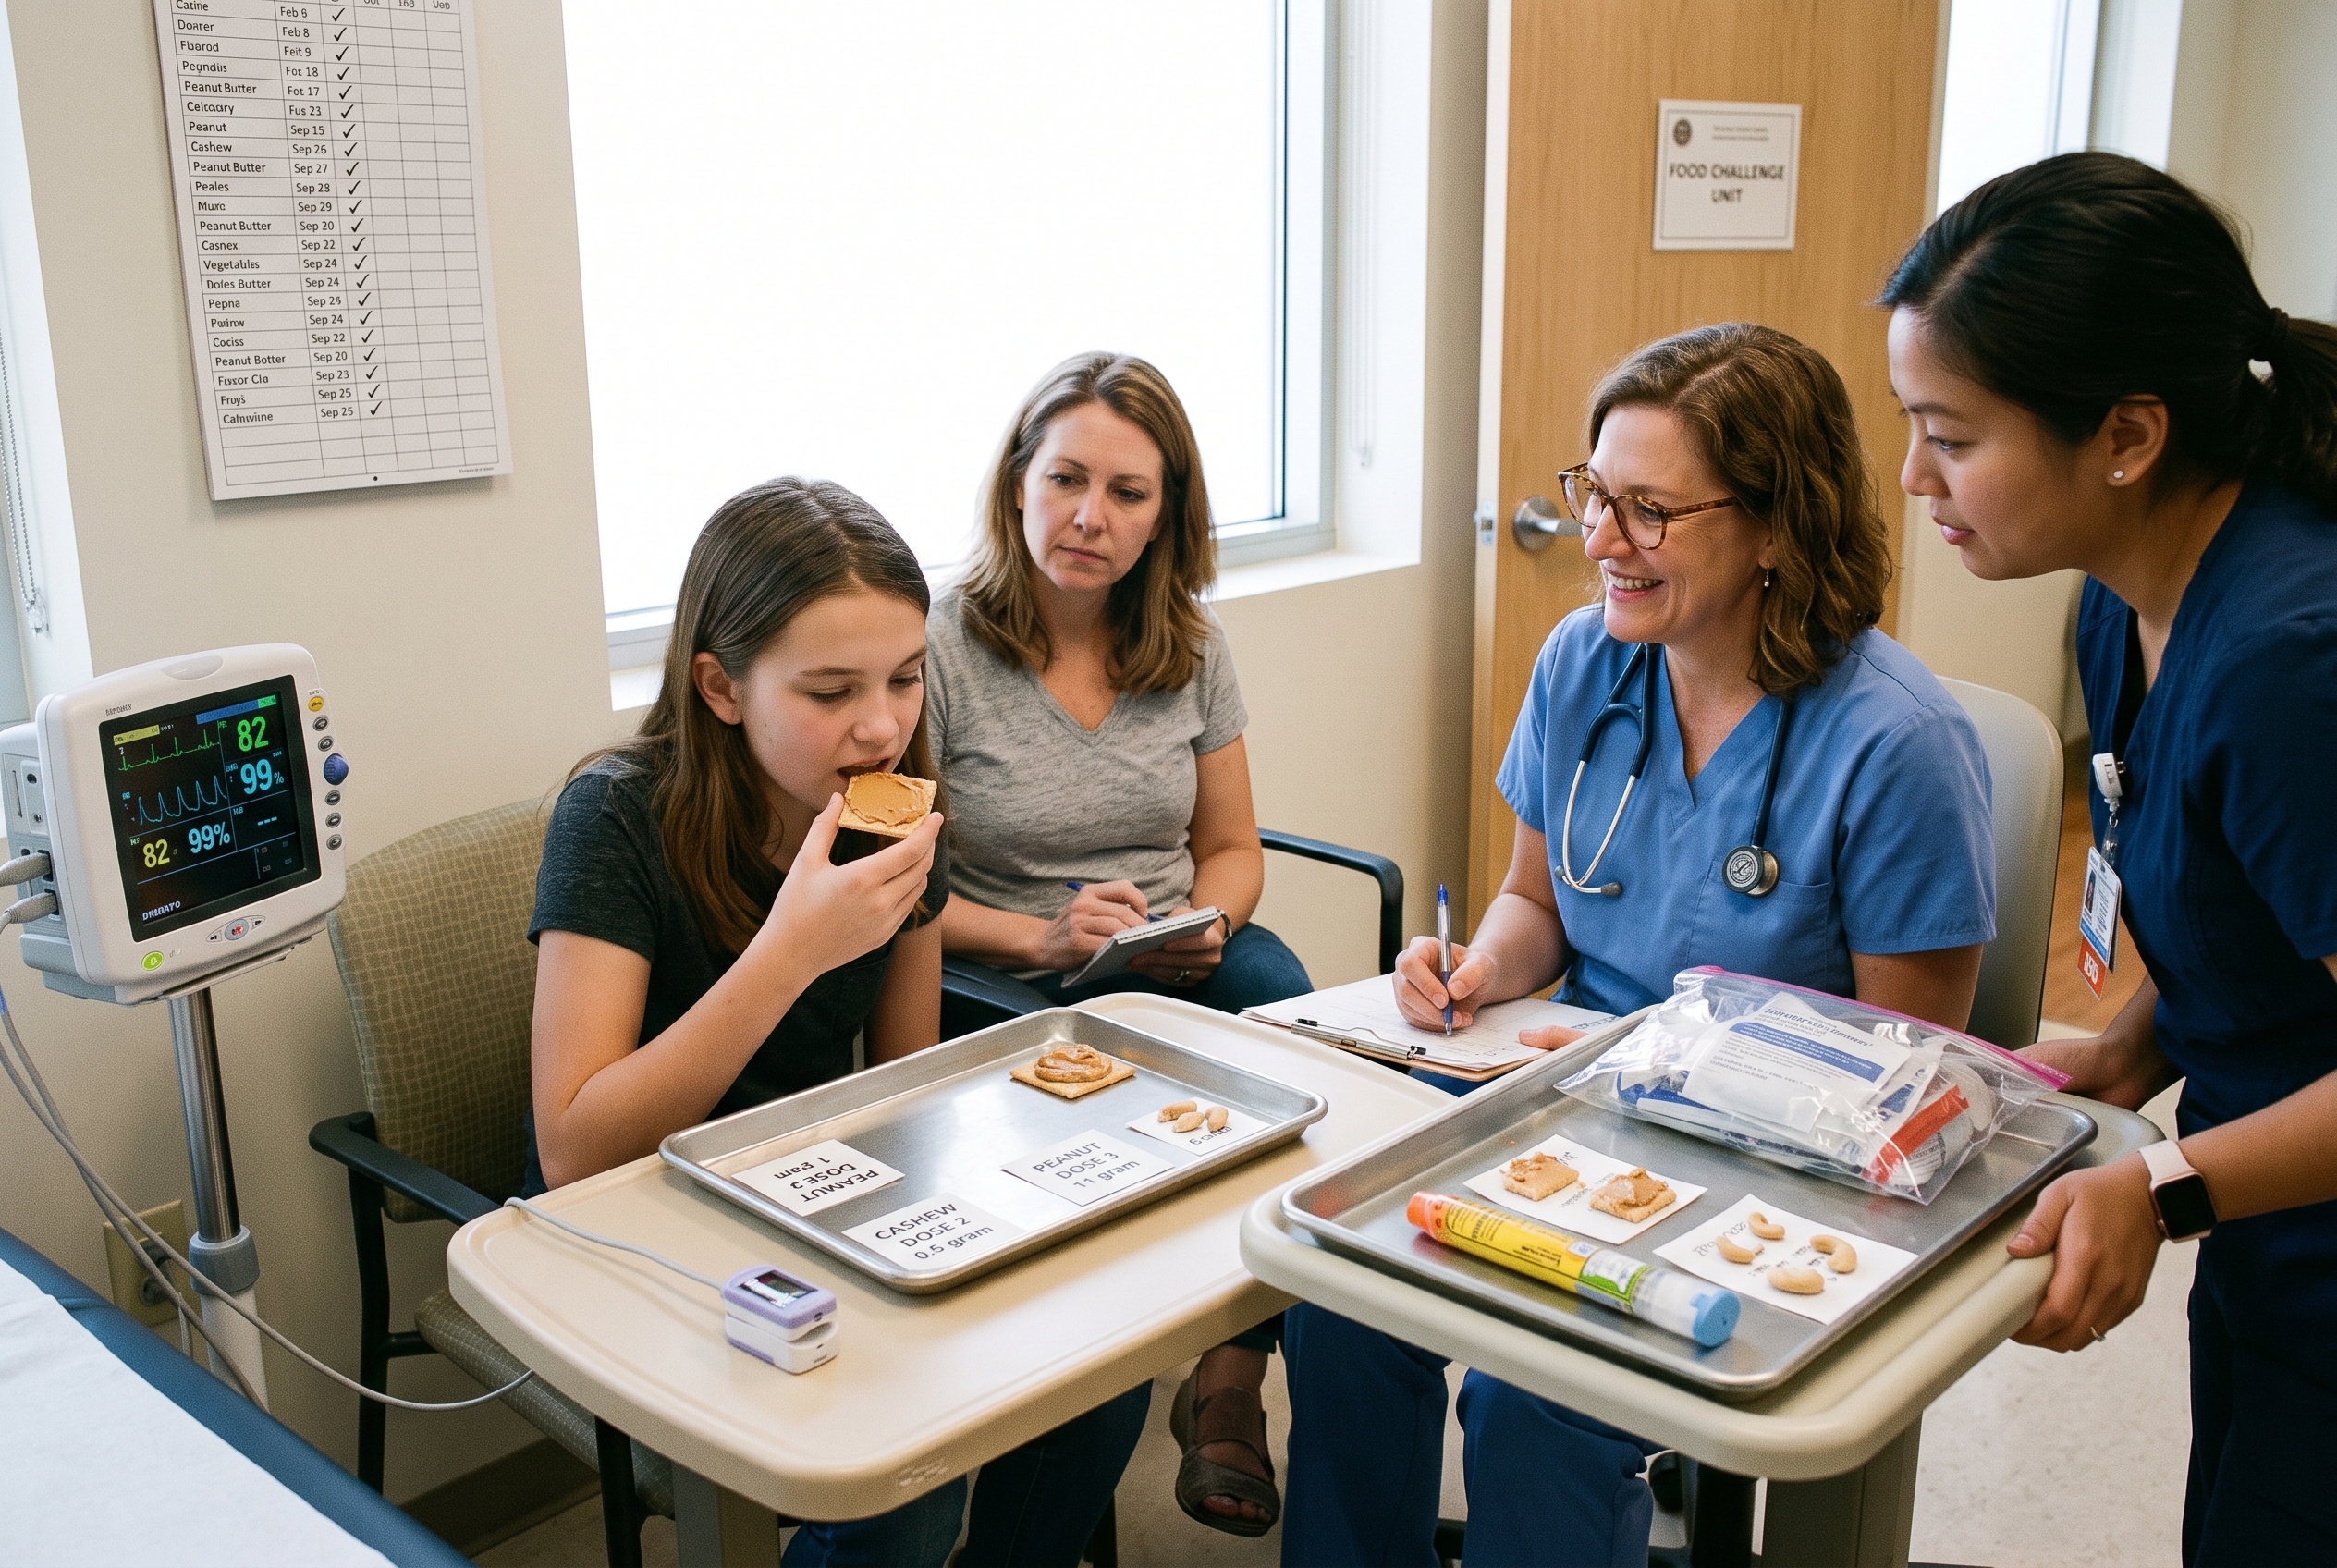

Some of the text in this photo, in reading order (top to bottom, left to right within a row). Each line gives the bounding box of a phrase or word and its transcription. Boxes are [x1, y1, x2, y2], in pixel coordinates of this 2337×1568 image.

[280, 7, 298, 18] Feb
[283, 27, 300, 37] Feb
[305, 48, 311, 56] 9
[306, 67, 319, 77] 18
[185, 81, 222, 92] Peanut
[225, 83, 257, 93] Butter
[308, 87, 319, 96] 17
[289, 105, 306, 115] Fus
[310, 106, 322, 116] 23
[189, 122, 324, 137] Peanut Sep 15
[191, 141, 326, 155] Cashew Sep 26
[193, 162, 327, 175] Peanut Butter Sep 27
[1669, 163, 1784, 180] FOOD CHALLENGE
[195, 181, 330, 194] Peales Sep 28
[1712, 188, 1742, 203] UNIT
[298, 202, 316, 213] Sep
[320, 202, 332, 212] 29
[200, 221, 334, 232] Peanut Butter Sep 20
[202, 240, 336, 251] Casnex Sep 22
[303, 259, 322, 270] Sep
[325, 259, 337, 267] 24
[239, 279, 271, 288] Butter
[305, 277, 324, 288] Sep
[327, 277, 339, 287] 24
[308, 296, 326, 307] Sep
[309, 314, 328, 325] Sep
[331, 314, 343, 324] 24
[213, 333, 345, 347] Cociss Sep 22
[215, 356, 251, 366] Peanut
[314, 352, 333, 363] Sep
[336, 351, 348, 361] 20
[316, 371, 335, 382] Sep
[337, 370, 349, 379] 23
[318, 389, 336, 400] Sep
[339, 388, 351, 398] 25
[321, 408, 338, 419] Sep
[342, 407, 353, 416] 25
[237, 716, 269, 752] 82
[189, 821, 231, 854] 99%
[142, 839, 170, 868] 82
[1032, 1142, 1101, 1172] PEANUT
[802, 1163, 856, 1184] DOSE
[1055, 1157, 1107, 1179] DOSE
[1097, 1161, 1141, 1181] gram
[875, 1203, 957, 1240] CASHEW
[899, 1217, 971, 1247] DOSE 2
[914, 1227, 994, 1259] 0.5 gram
